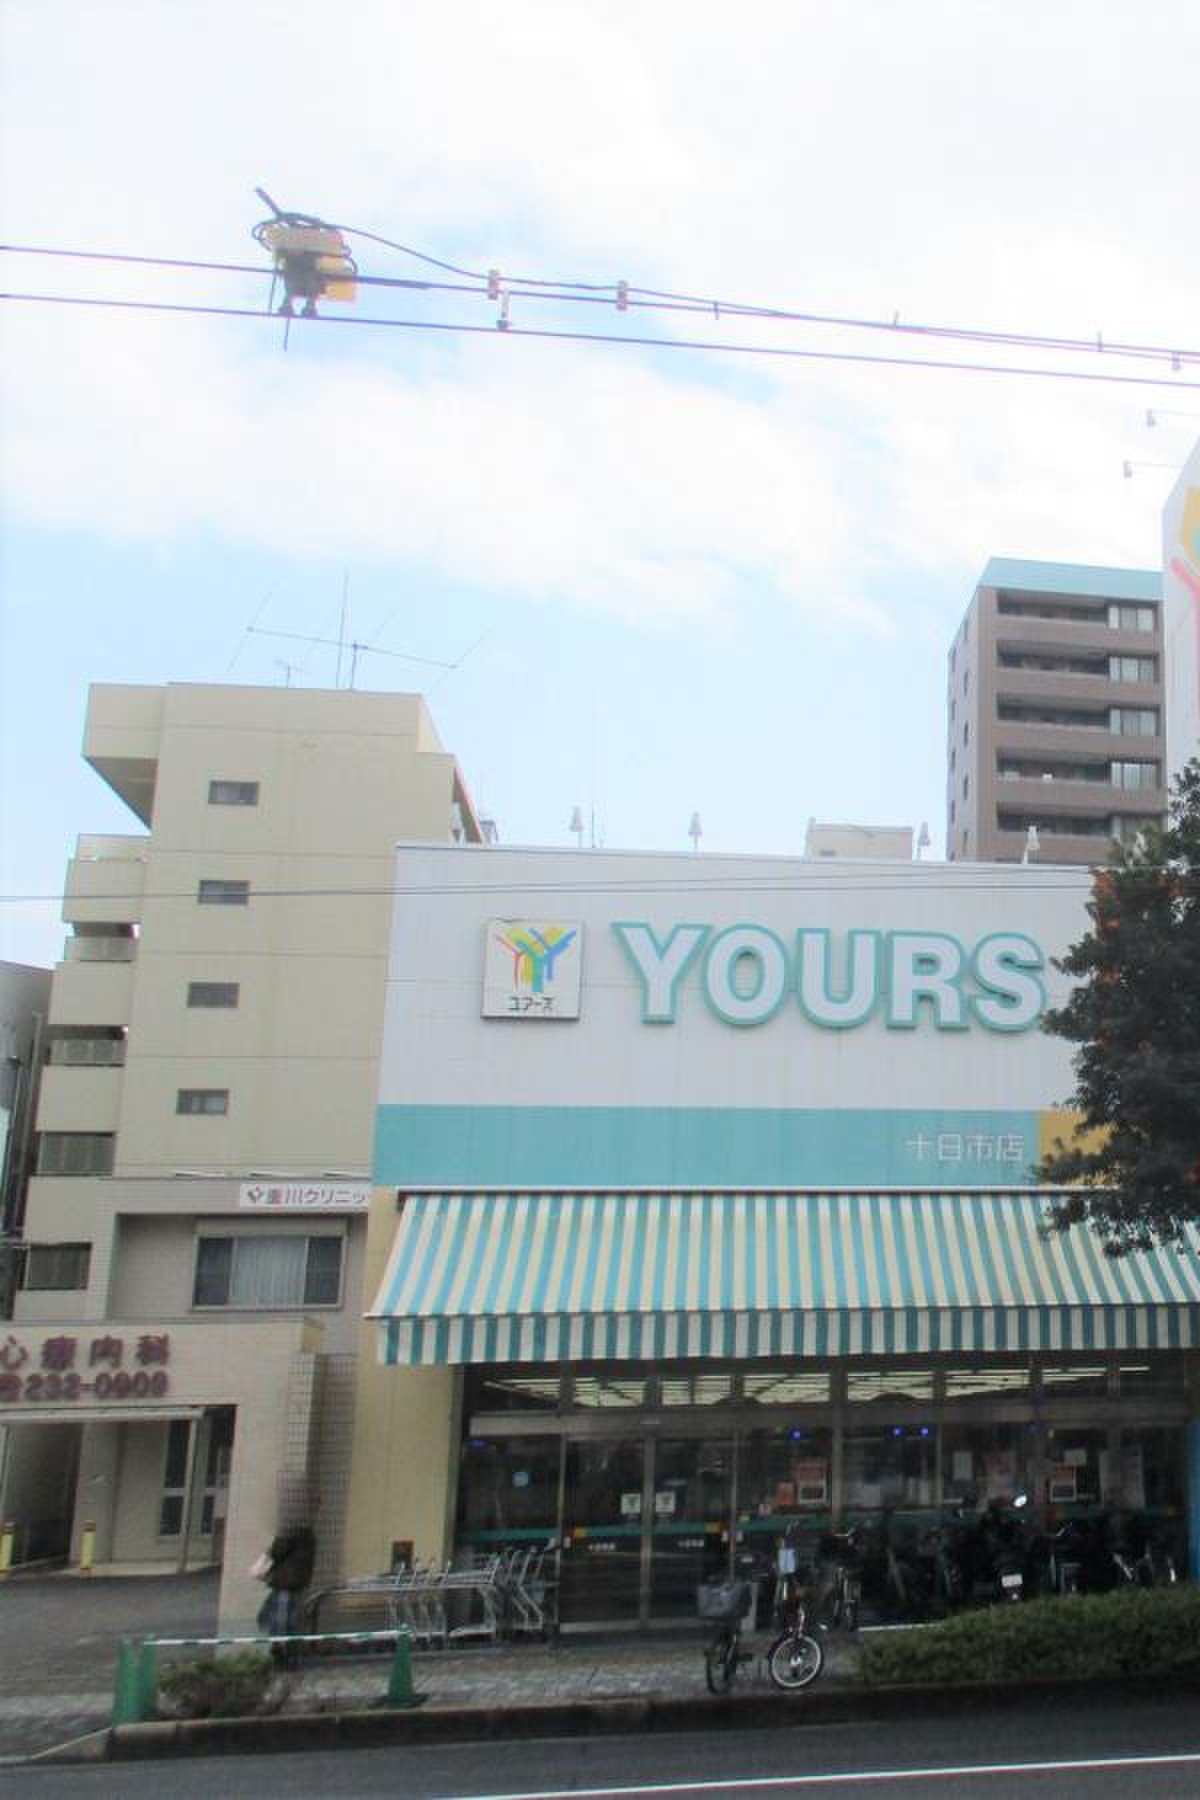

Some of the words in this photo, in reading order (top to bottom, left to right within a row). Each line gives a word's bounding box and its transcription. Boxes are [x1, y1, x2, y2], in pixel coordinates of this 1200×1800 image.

[610, 920, 1047, 1032] YOURS
[905, 1131, 1024, 1161] 十日市店
